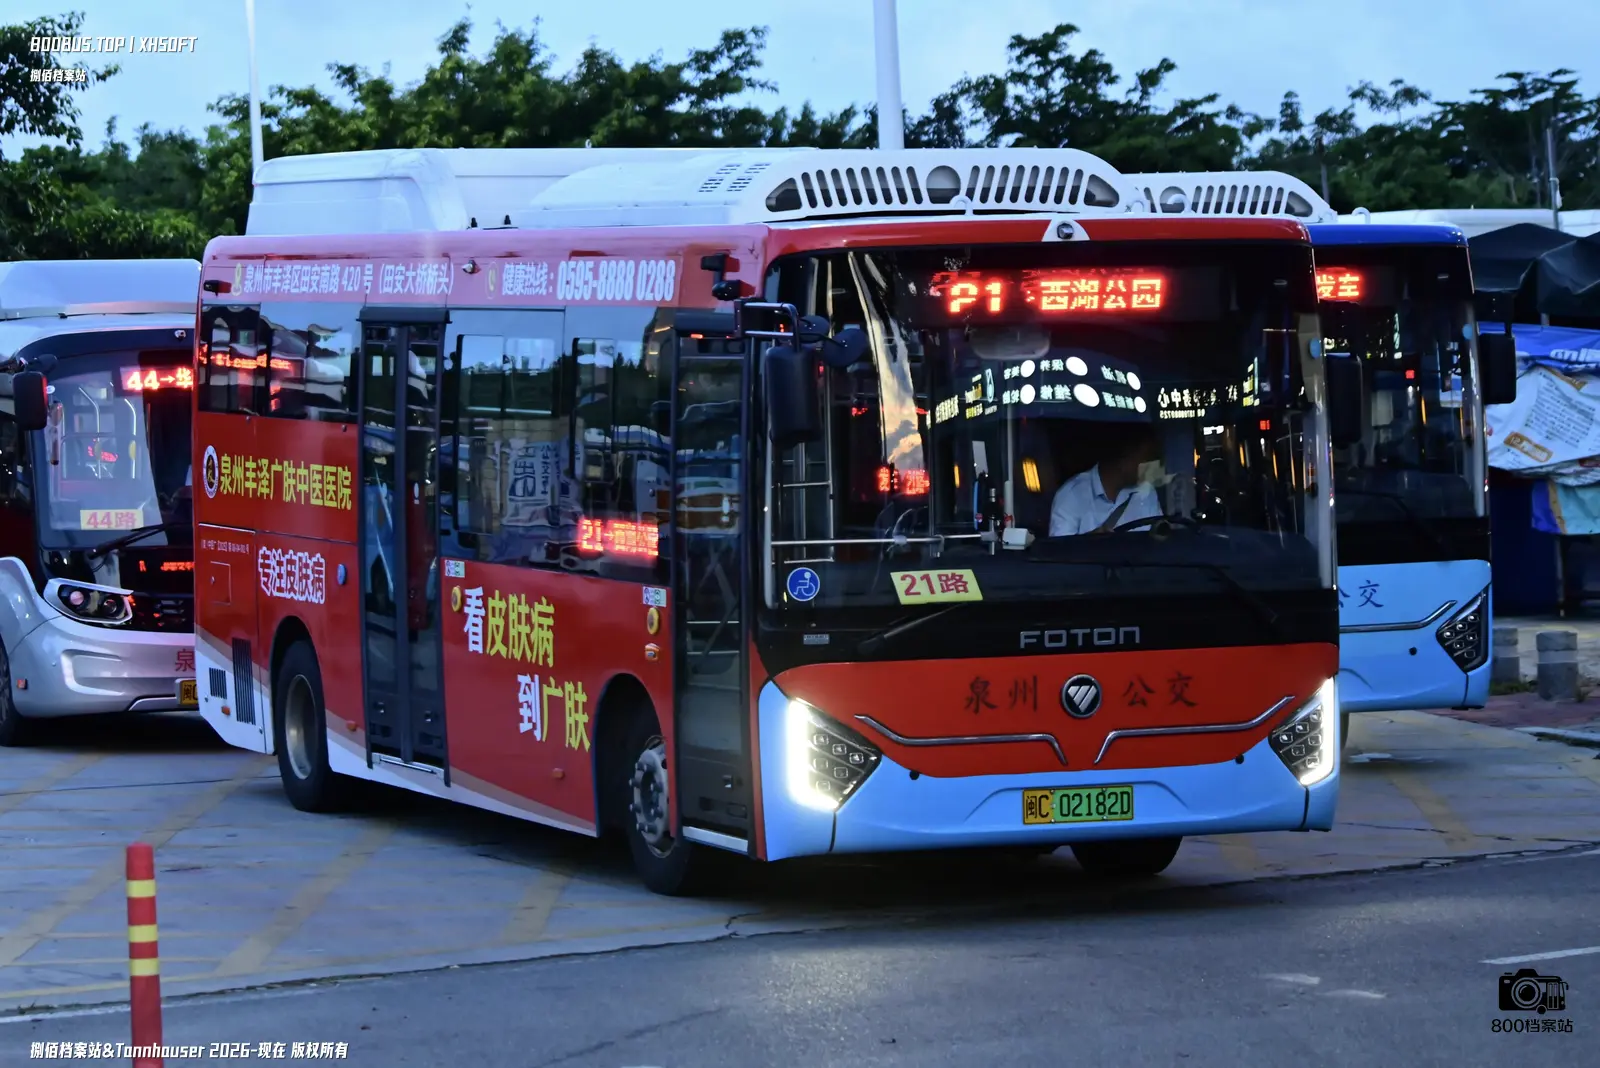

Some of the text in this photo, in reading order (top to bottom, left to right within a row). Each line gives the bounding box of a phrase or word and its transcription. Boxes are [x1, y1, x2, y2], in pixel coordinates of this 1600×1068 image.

[1040, 279, 1161, 311] 西湖公园
[219, 453, 353, 511] 泉州丰泽广肤中医医院
[86, 511, 137, 529] 44路
[257, 546, 326, 604] 专注皮肤病
[900, 572, 969, 596] 21路
[463, 586, 555, 668] 看皮肤病
[1020, 626, 1140, 649] FOTON
[964, 671, 1199, 715] 泉州 公交
[517, 673, 591, 752] 到广肤
[1025, 791, 1131, 819] 闽C 02182D
